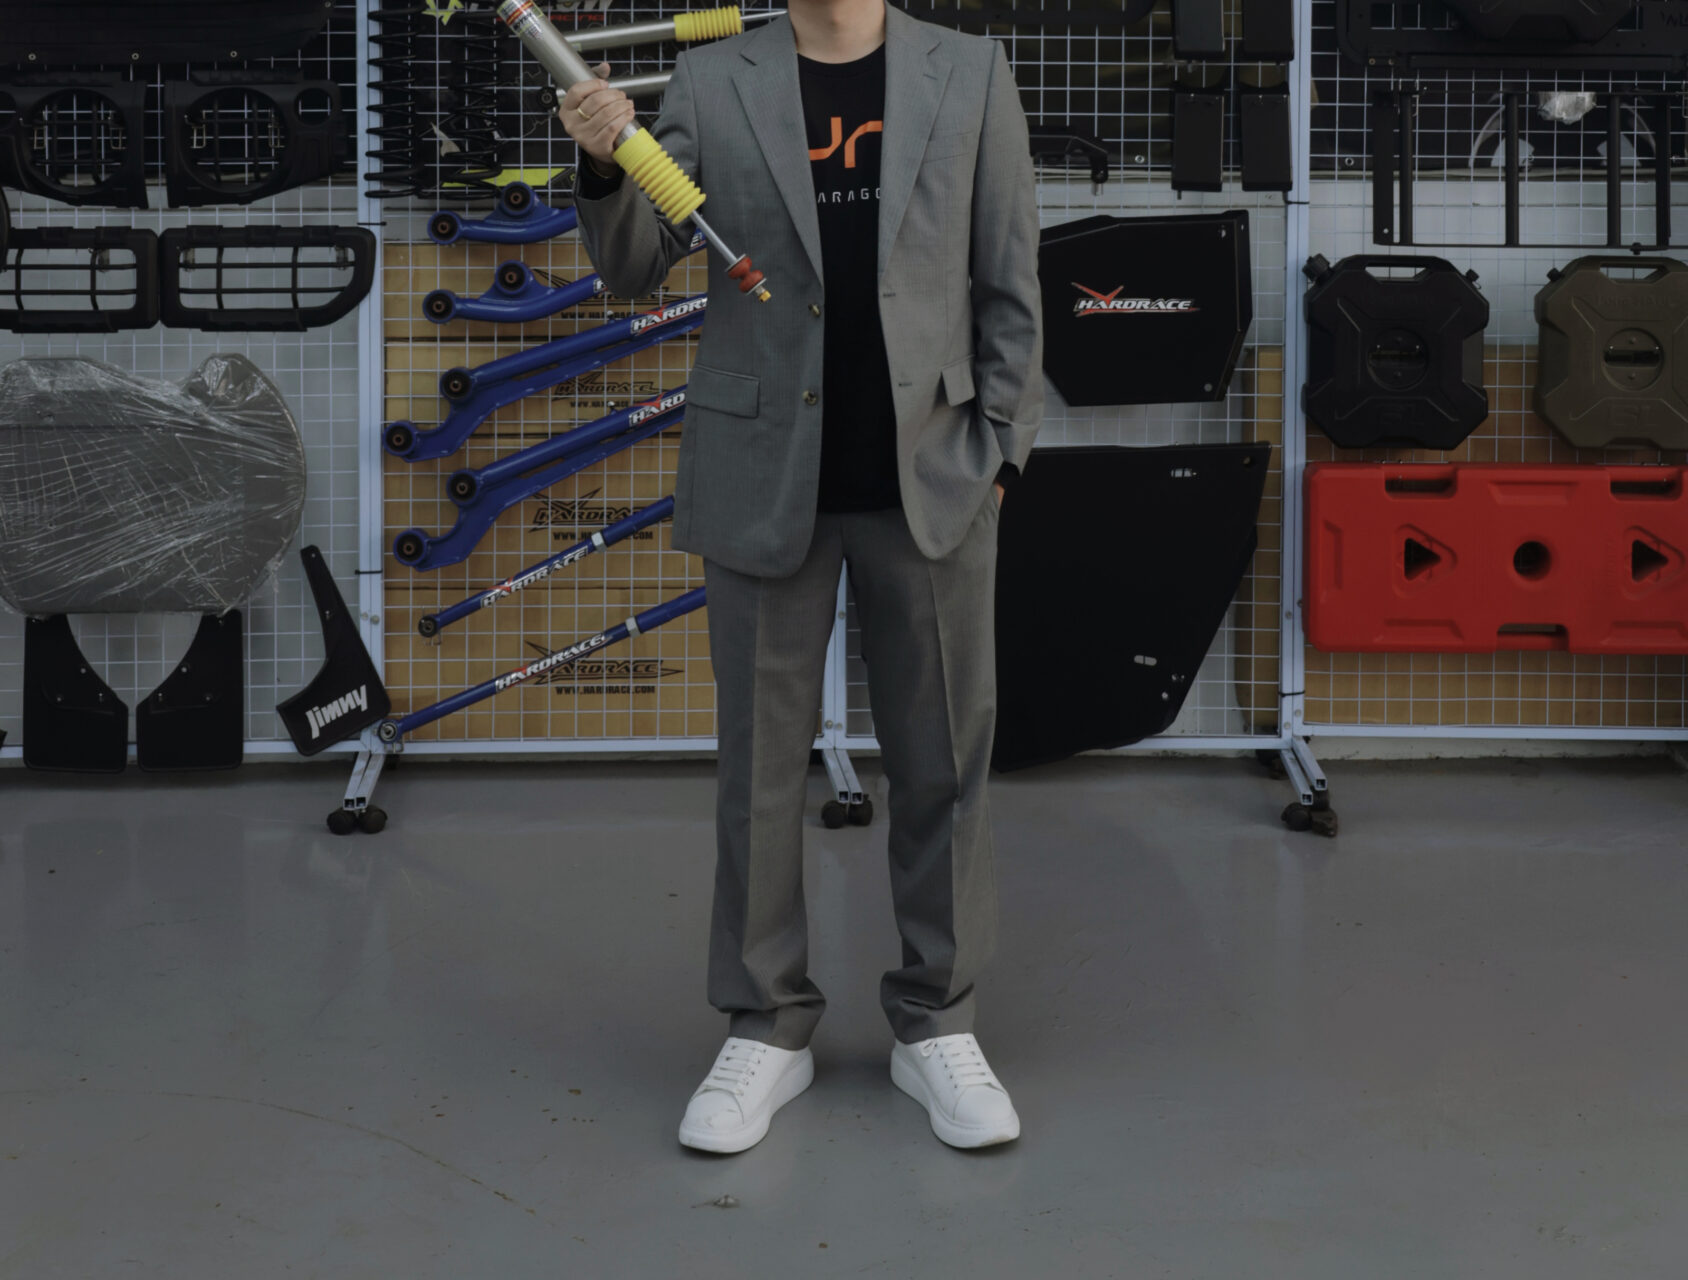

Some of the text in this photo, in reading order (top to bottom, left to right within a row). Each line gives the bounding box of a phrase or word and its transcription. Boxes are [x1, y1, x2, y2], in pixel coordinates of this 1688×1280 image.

[1076, 298, 1194, 312] HARDRACE
[481, 545, 588, 608] HARDRACE
[496, 632, 606, 693] HARDRACE
[549, 661, 661, 677] ARDRACE
